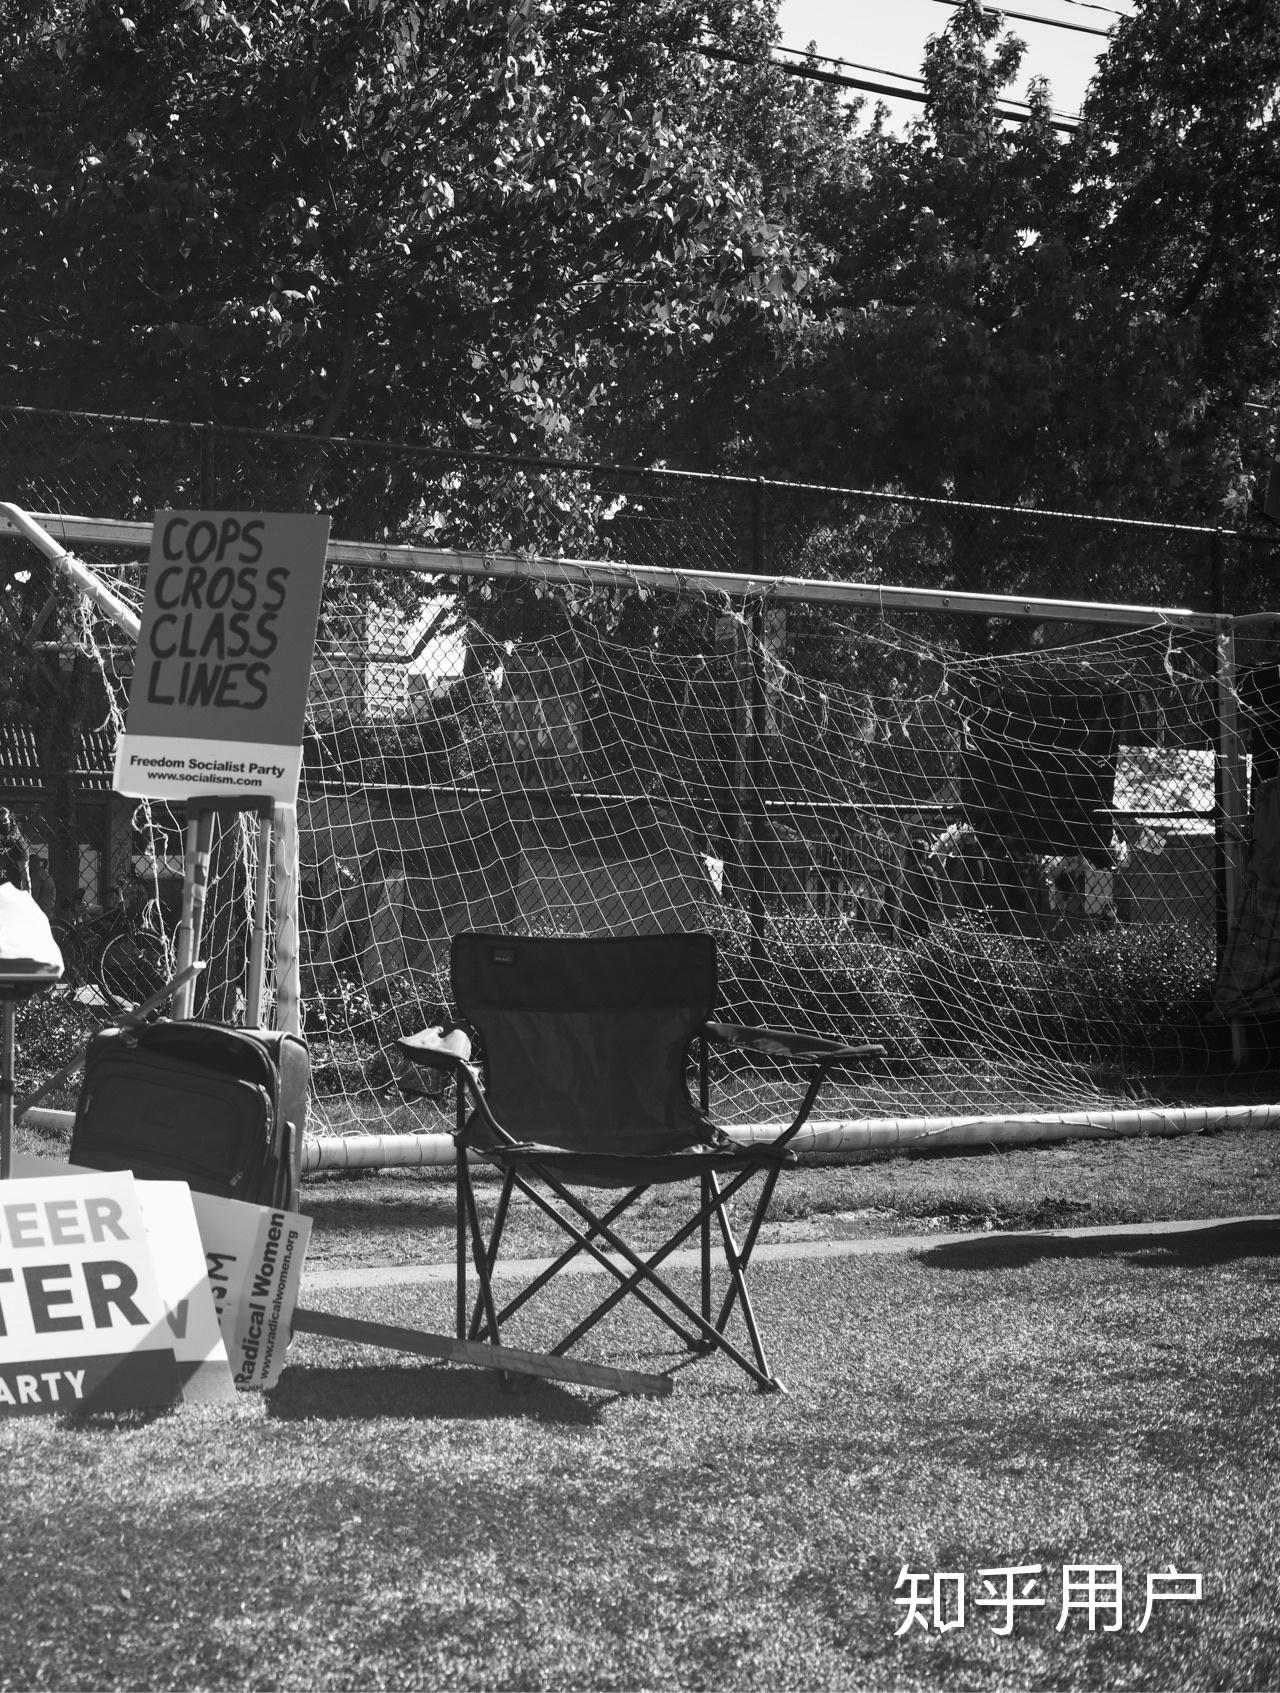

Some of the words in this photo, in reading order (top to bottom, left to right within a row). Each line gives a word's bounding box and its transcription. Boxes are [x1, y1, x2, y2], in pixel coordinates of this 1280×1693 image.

[161, 517, 265, 565] COPS
[154, 566, 291, 612] CROSS
[149, 612, 279, 660] CLASS
[147, 660, 271, 710] LINES
[130, 754, 185, 770] Freedom
[188, 757, 246, 773] Socialist
[248, 762, 285, 779] Party
[147, 770, 263, 787] www.socialism.com
[234, 1302, 266, 1383] Radical
[251, 1212, 286, 1298] Women
[260, 1230, 299, 1380] www.radicalwomen.org
